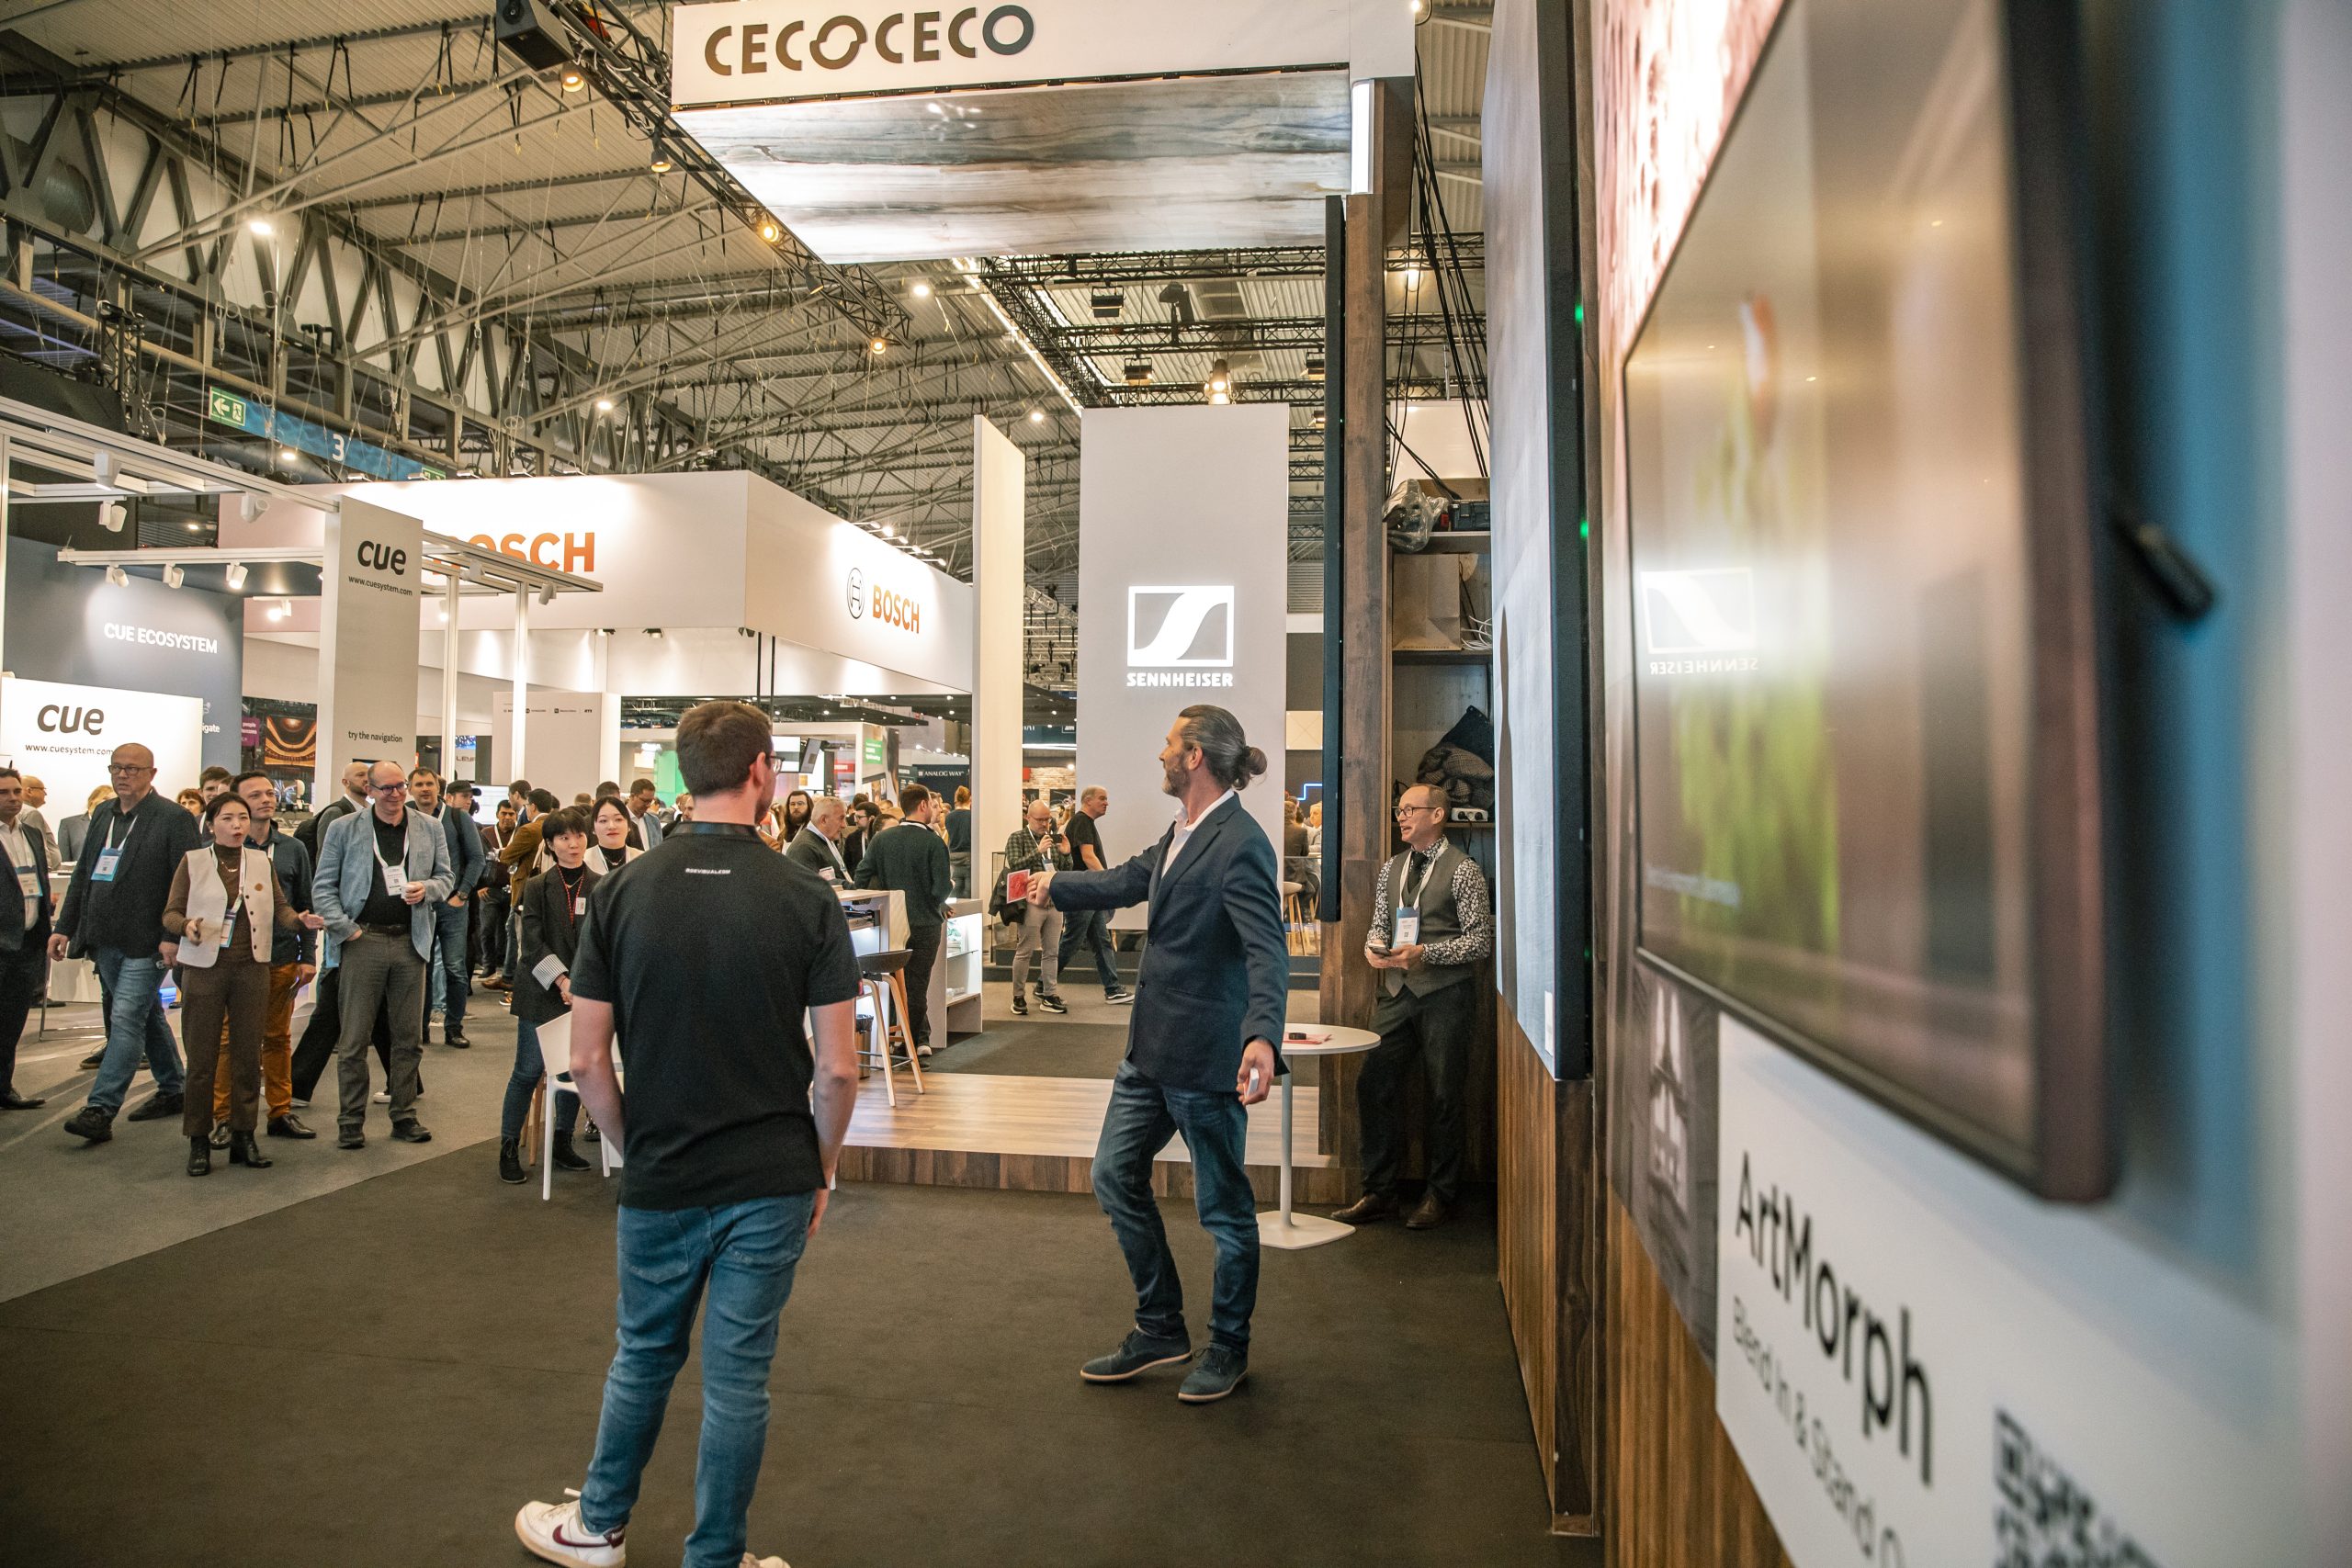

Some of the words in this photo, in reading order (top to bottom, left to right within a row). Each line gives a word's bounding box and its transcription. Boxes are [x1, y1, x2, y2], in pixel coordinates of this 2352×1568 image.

[705, 5, 1035, 76] CECOCECO
[332, 433, 345, 462] 3
[357, 540, 407, 576] cue
[348, 575, 413, 596] www.cuesystem.com
[872, 584, 920, 634] BOSCH
[104, 622, 135, 642] CUE
[137, 627, 218, 654] ECOSYSTEM
[1126, 672, 1234, 687] SENNHEISER
[38, 704, 105, 736] cue
[25, 743, 115, 756] www.cuesystem.com
[348, 730, 358, 741] try
[358, 730, 370, 740] the
[370, 732, 403, 744] navigation
[1736, 1148, 1934, 1490] ArtMorph
